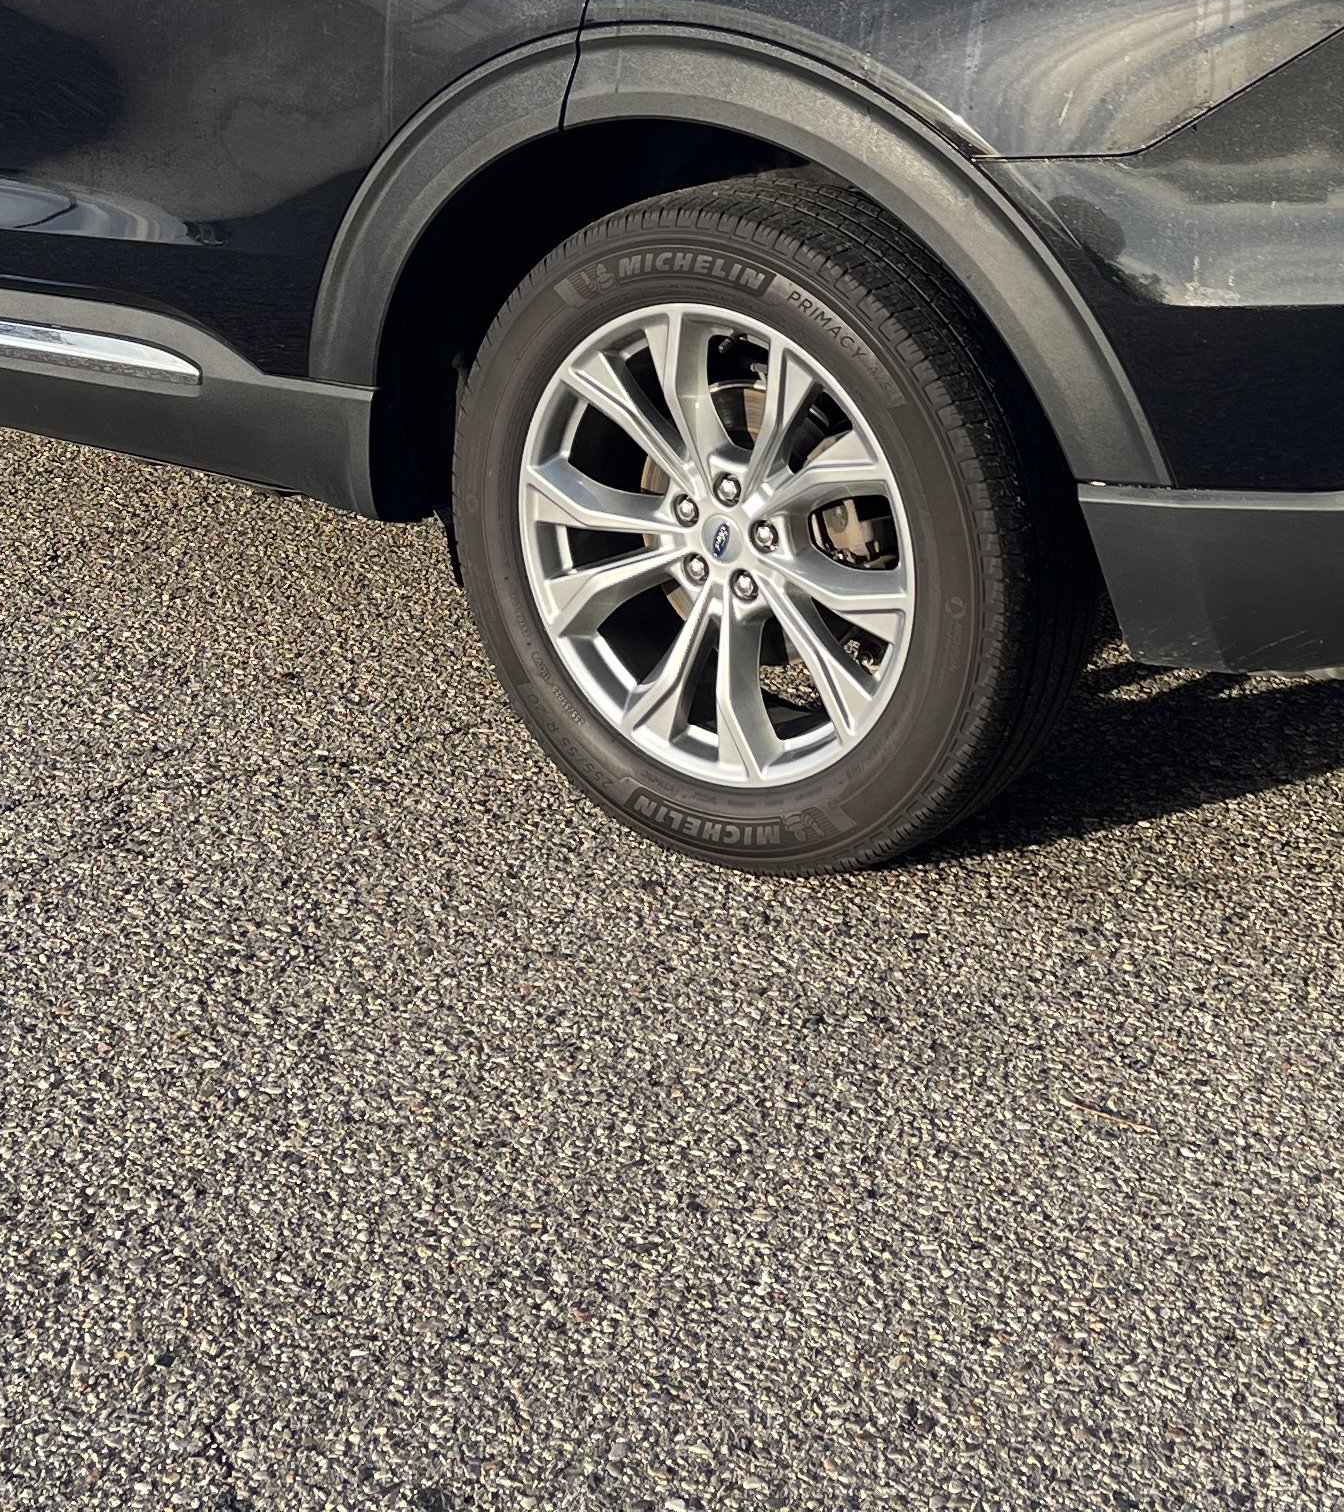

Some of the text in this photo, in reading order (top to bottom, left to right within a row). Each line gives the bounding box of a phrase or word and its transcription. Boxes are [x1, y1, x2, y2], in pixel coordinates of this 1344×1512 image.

[618, 252, 766, 289] MICHELIN
[786, 290, 867, 359] PRIMACY
[527, 693, 614, 789] 255/55 R 20
[633, 795, 781, 846] MICHELIN
